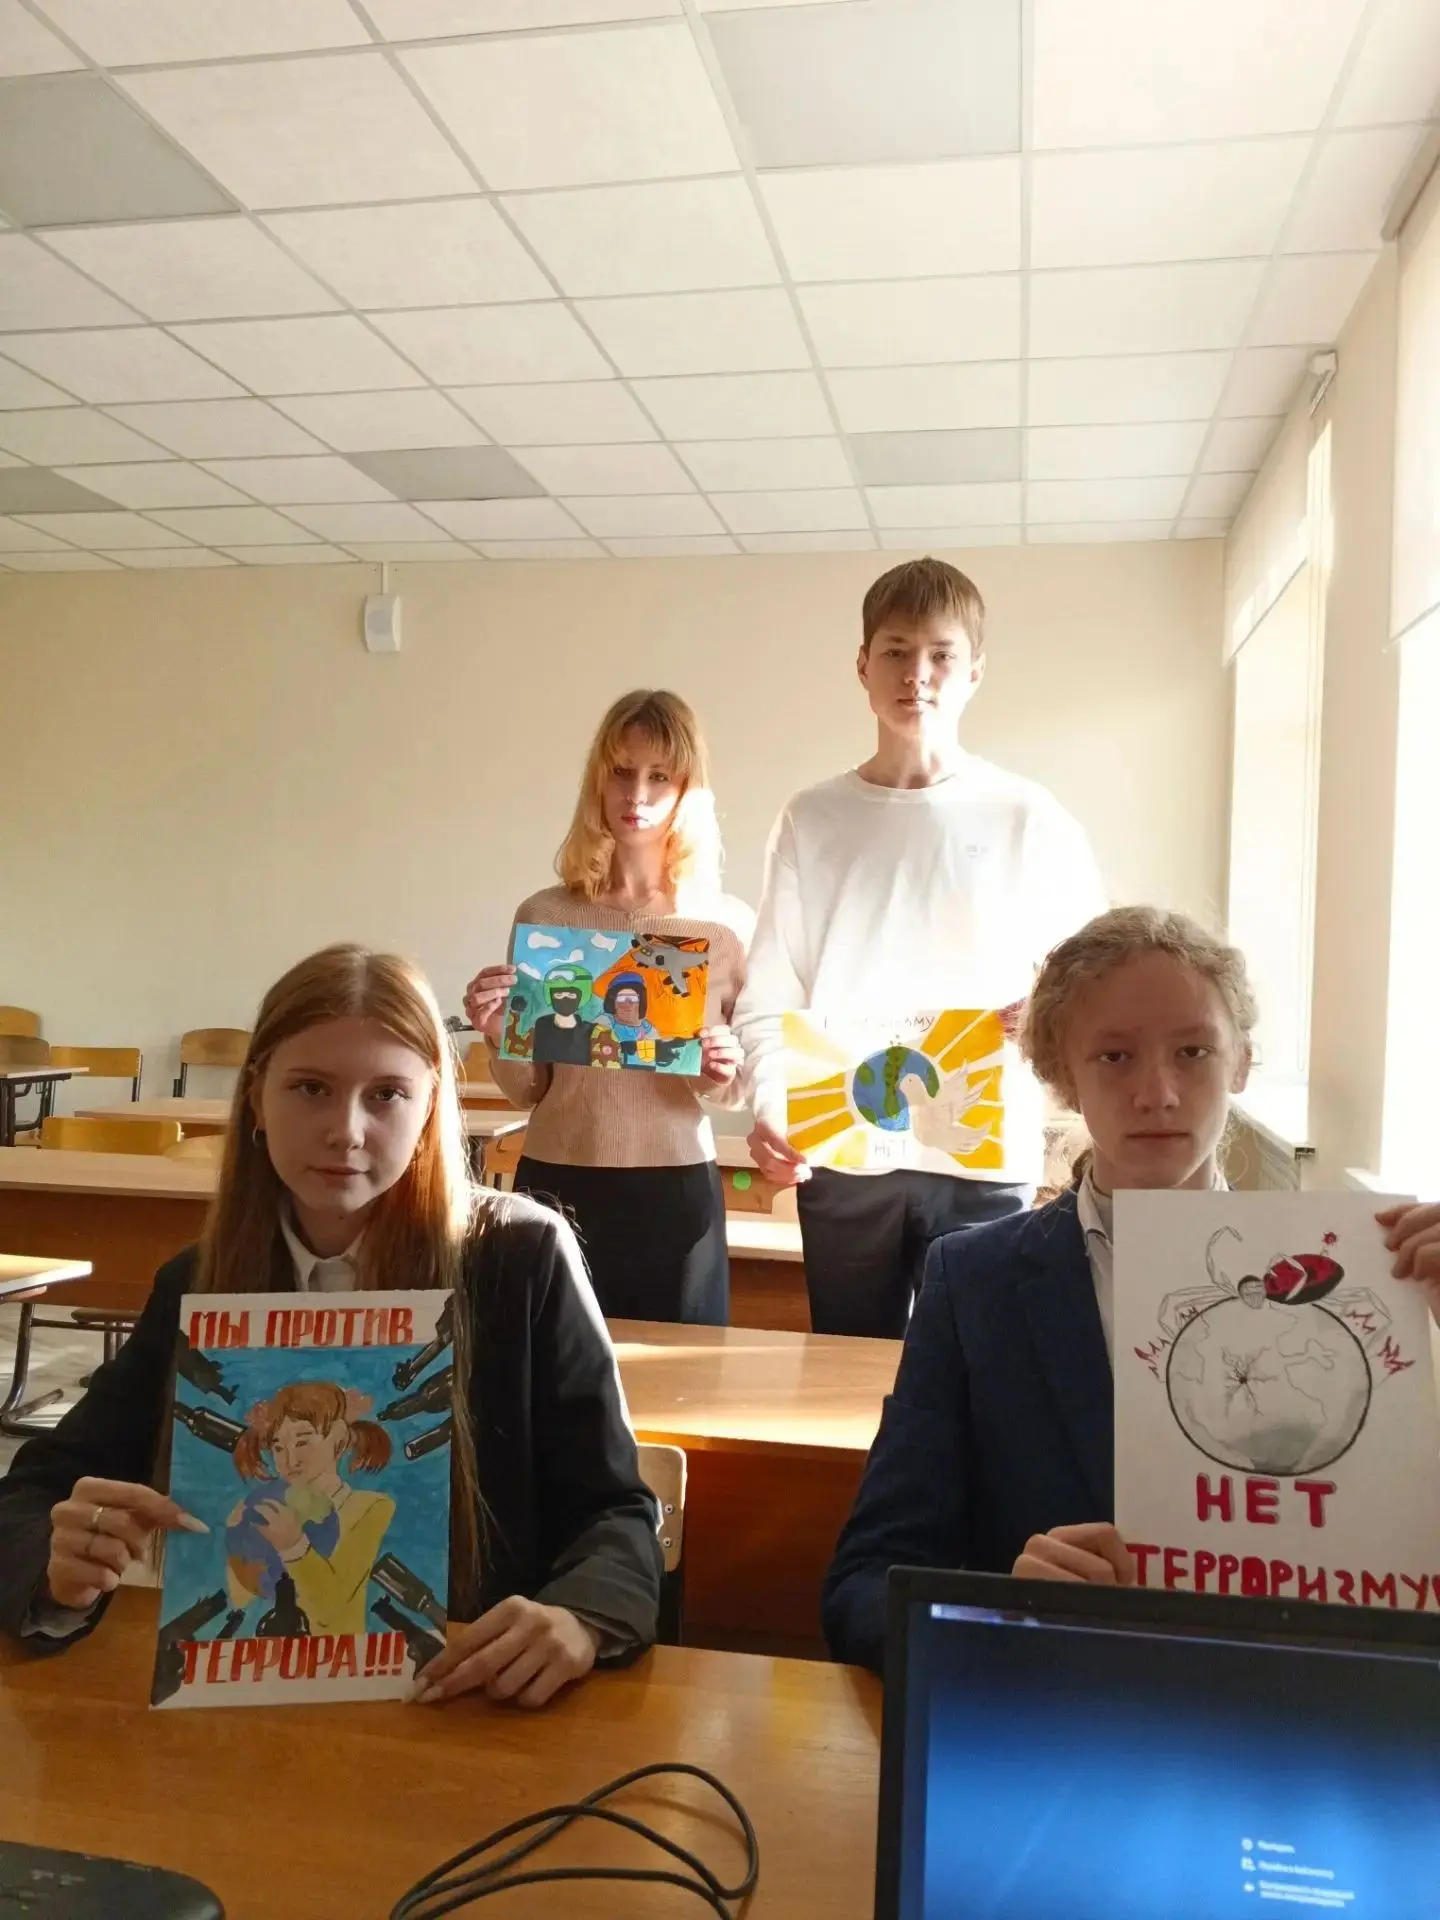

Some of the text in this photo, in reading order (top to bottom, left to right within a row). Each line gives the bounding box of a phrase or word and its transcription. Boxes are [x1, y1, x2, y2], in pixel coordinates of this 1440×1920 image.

[189, 1307, 413, 1349] МЫ ПРОТИВ
[1196, 1472, 1337, 1527] НЕТ
[1126, 1543, 1440, 1609] ТЕРРОРИЗМУ
